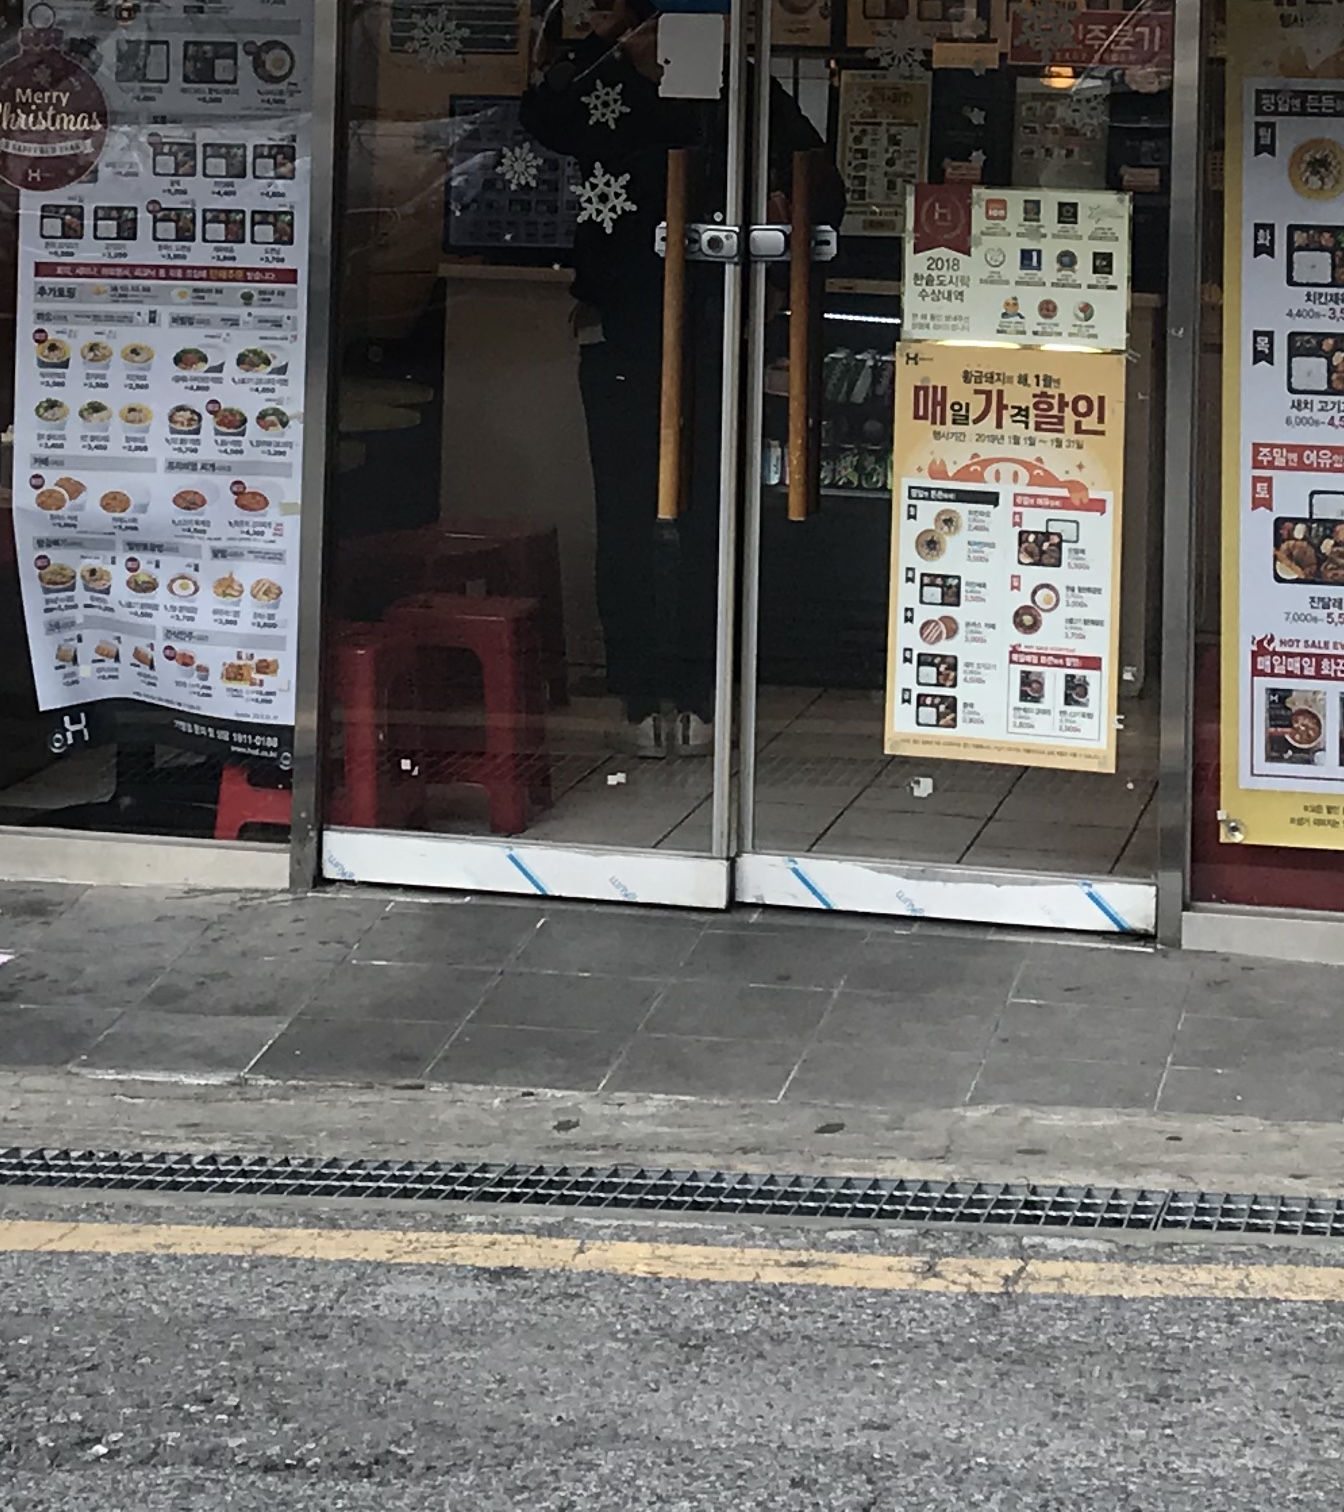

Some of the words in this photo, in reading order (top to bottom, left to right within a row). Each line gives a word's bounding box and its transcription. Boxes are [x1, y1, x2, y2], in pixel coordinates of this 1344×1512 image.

[15, 87, 71, 108] Merry
[1255, 229, 1272, 247] 화
[926, 256, 961, 272] 2018
[917, 288, 965, 304] 수상내역
[1254, 482, 1270, 499] 토
[1308, 595, 1344, 611] 진달래
[1279, 637, 1301, 650] HOT
[1303, 639, 1330, 652] SALE
[1256, 654, 1317, 676] 매일매일
